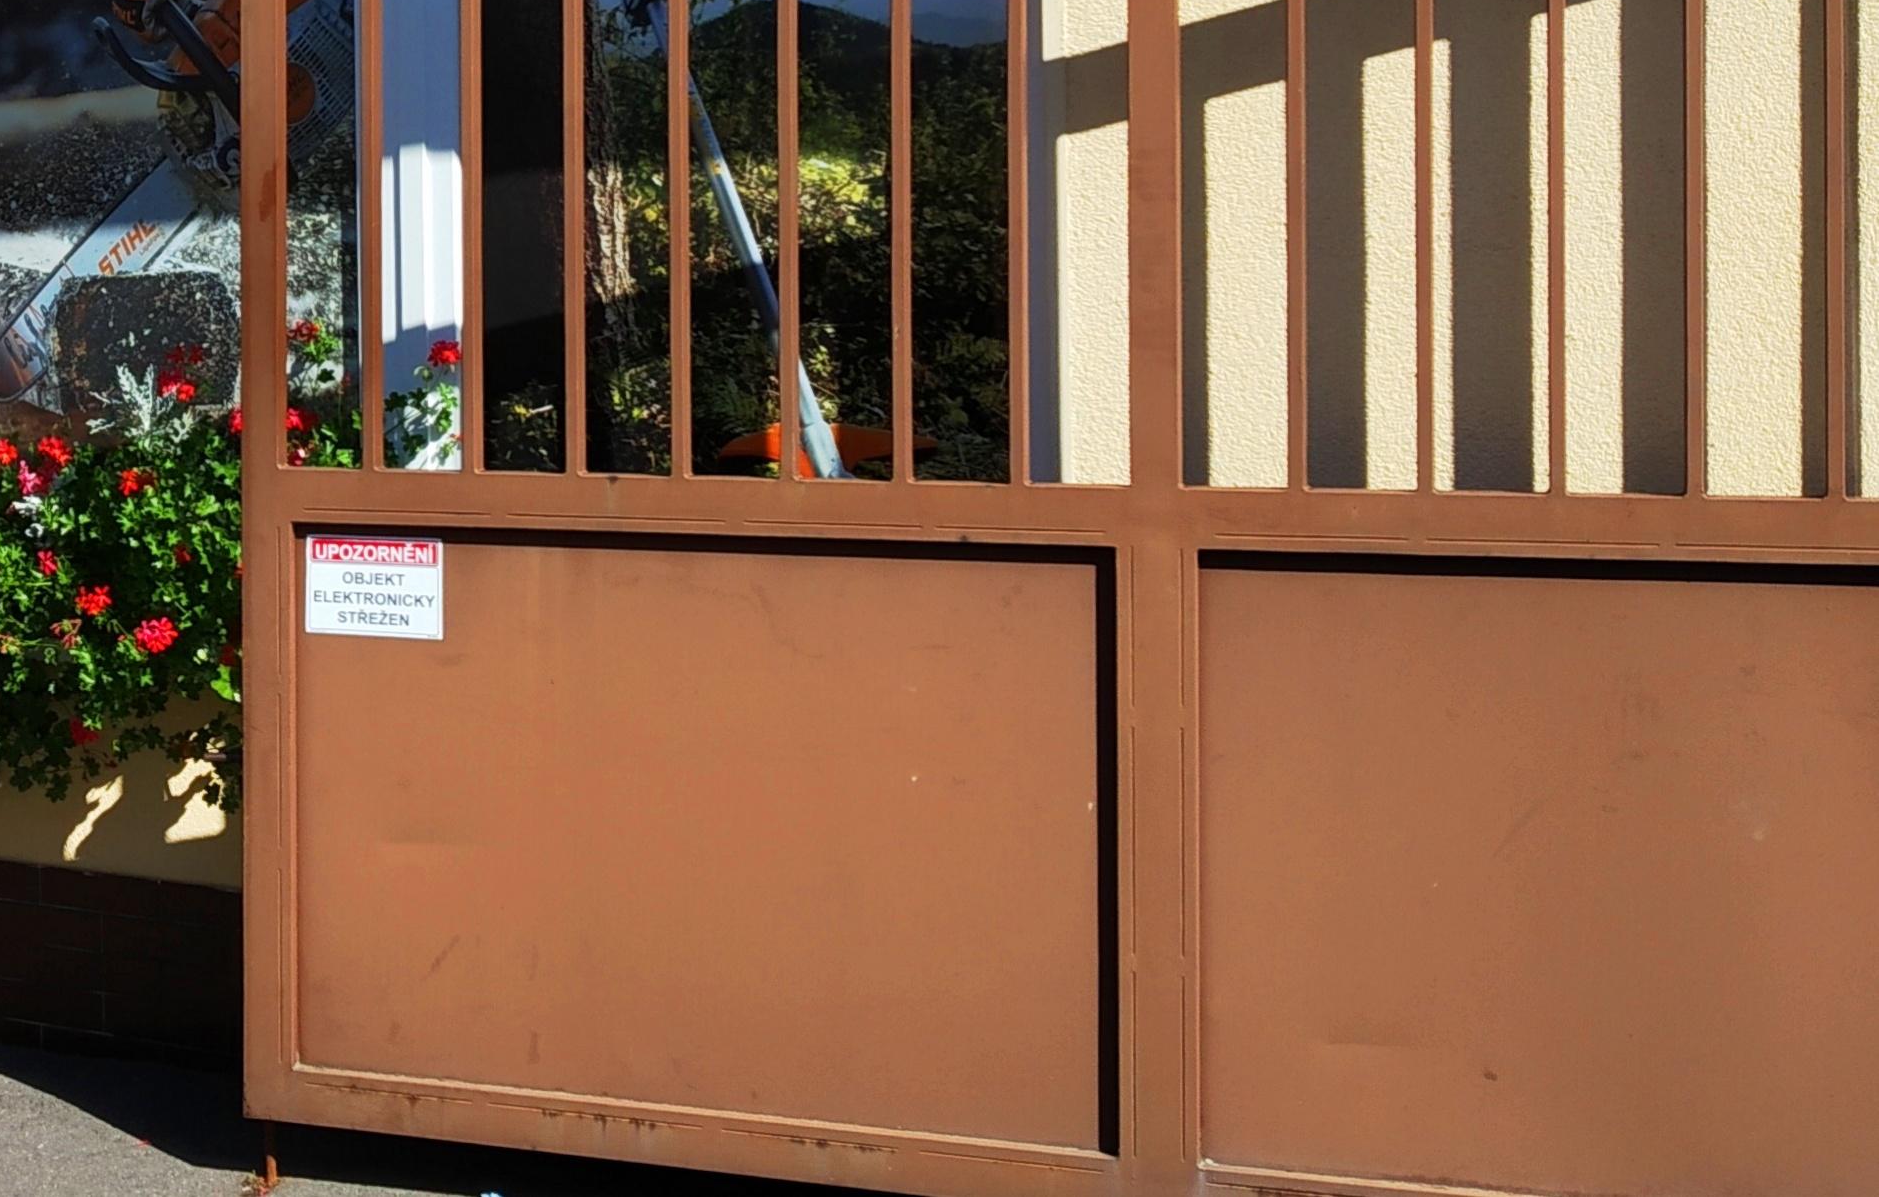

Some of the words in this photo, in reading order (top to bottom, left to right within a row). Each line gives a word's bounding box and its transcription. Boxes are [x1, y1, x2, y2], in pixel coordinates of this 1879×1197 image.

[98, 217, 157, 276] STIHL
[315, 541, 434, 563] UPOZORNĚNÍ
[342, 571, 405, 586] OBJEKT
[313, 590, 435, 608] ELEKTRONICKY
[337, 609, 410, 626] STŘEŽEN
